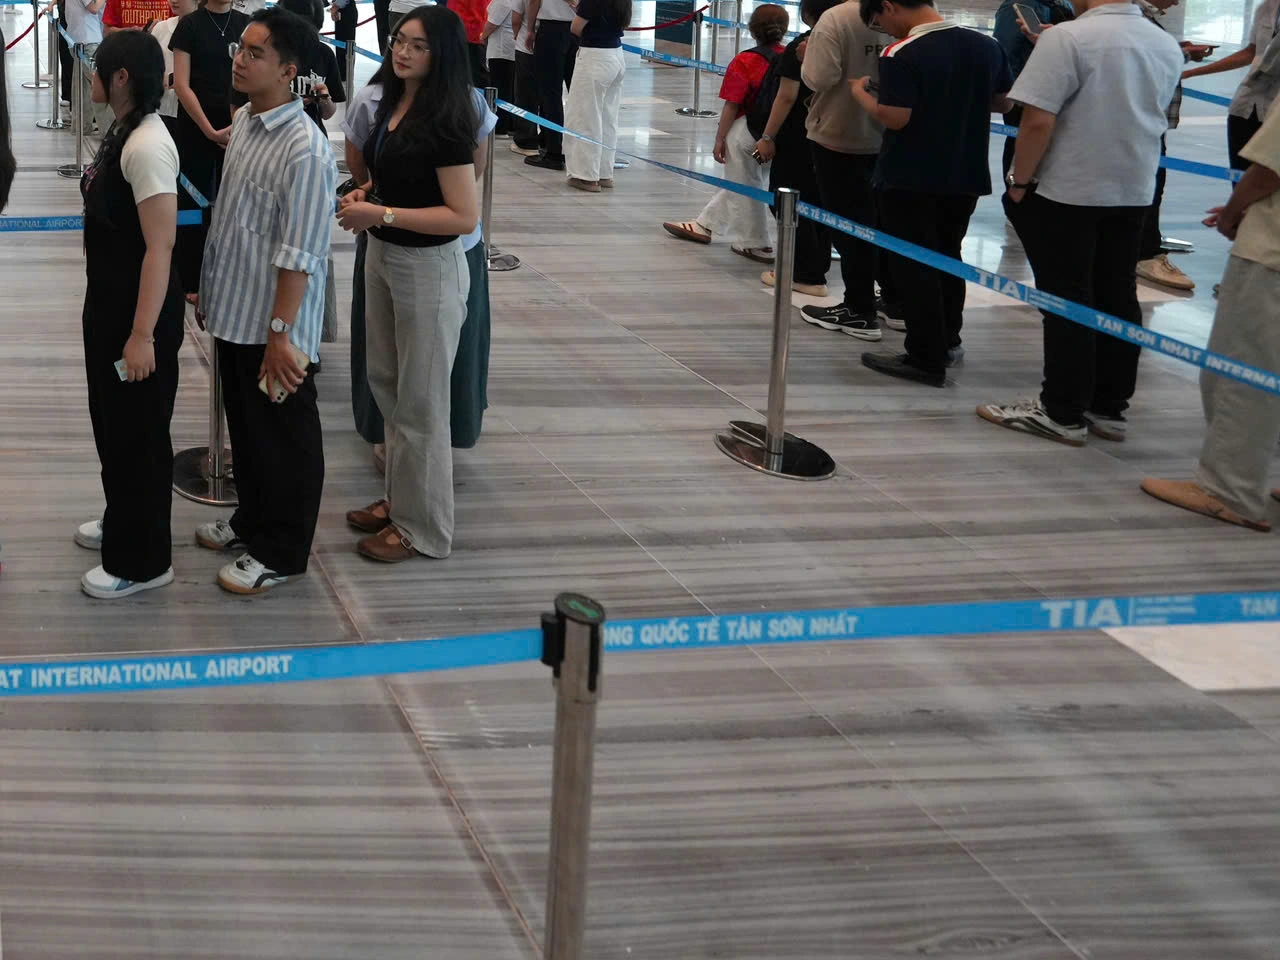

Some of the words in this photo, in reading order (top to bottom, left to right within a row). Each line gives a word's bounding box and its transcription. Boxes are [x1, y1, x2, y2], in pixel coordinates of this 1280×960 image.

[46, 218, 83, 228] AIRPOR
[975, 267, 1021, 300] TIA
[1096, 314, 1122, 334] TAN
[1126, 327, 1156, 346] SON
[1160, 338, 1201, 362] NHAT
[1206, 354, 1280, 390] INTERNA
[1040, 598, 1123, 628] TIA
[1240, 597, 1278, 616] TAN
[640, 617, 689, 645] QUỐC
[697, 614, 720, 641] TẾ
[727, 616, 762, 640] TÂN
[768, 616, 804, 638] SƠN
[810, 610, 859, 636] NHẤT
[31, 660, 197, 688] INTERNATIONAL
[205, 655, 293, 679] AIRPORT
